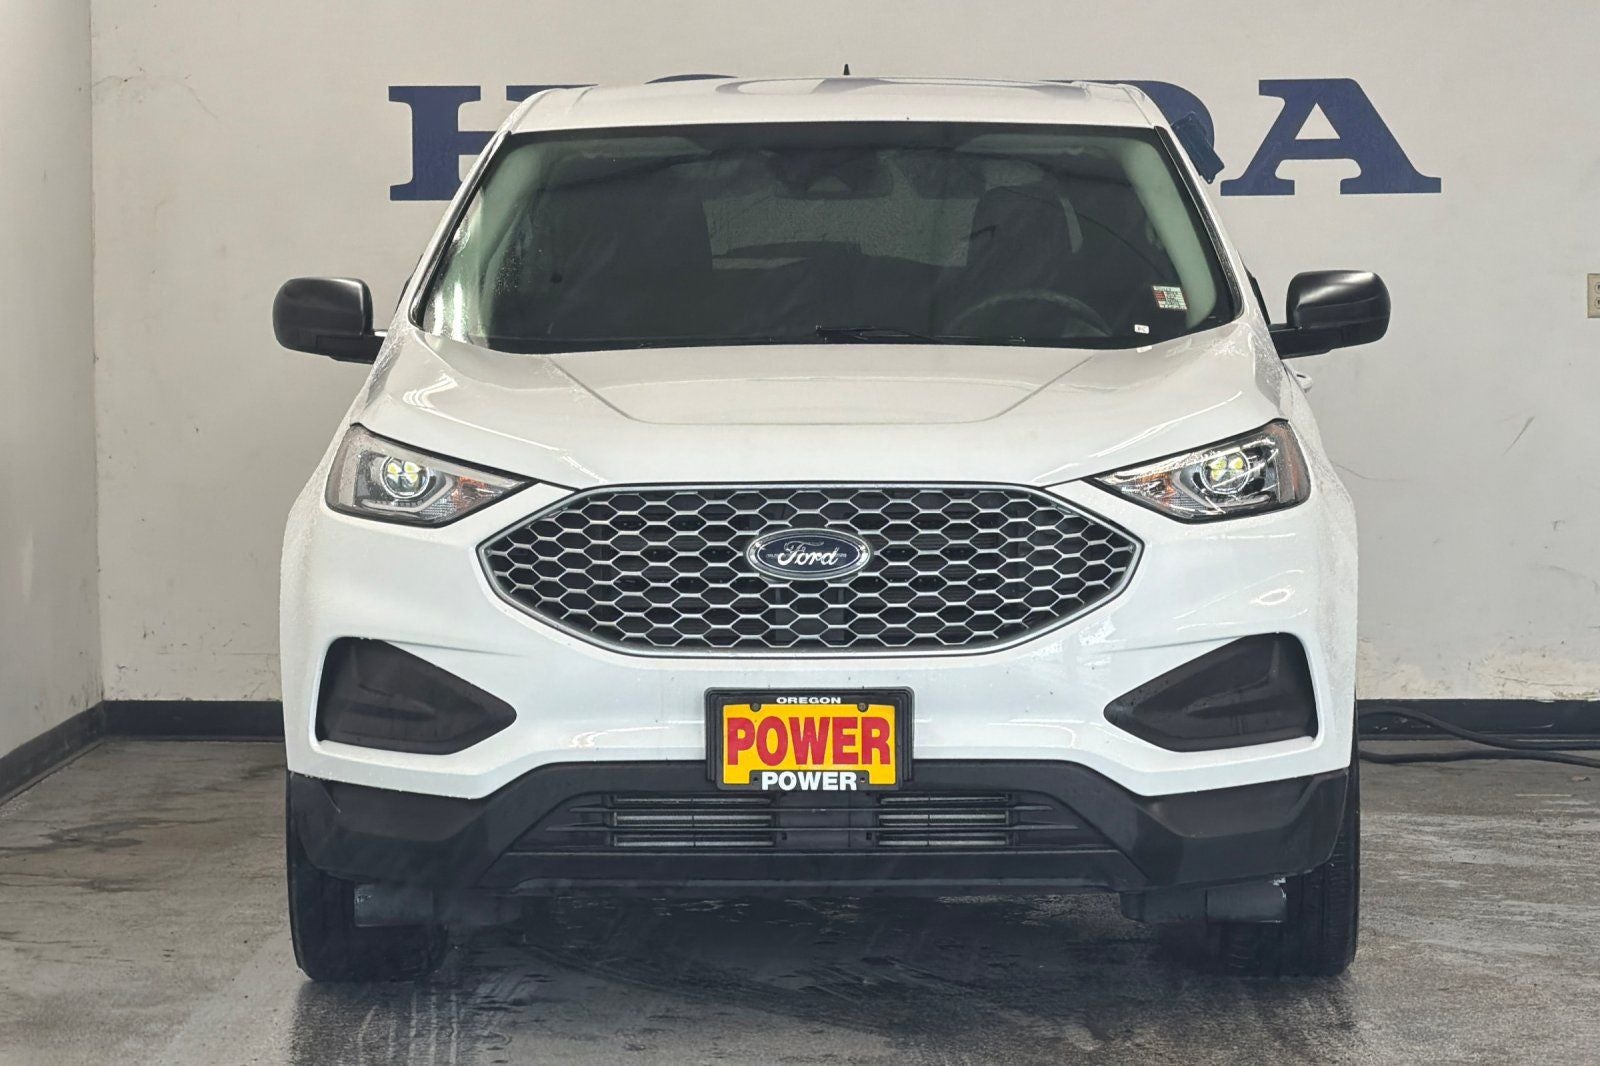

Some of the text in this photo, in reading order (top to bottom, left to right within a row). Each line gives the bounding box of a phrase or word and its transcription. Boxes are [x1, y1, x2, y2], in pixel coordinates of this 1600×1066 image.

[777, 540, 840, 565] Ford
[776, 696, 842, 705] OREGON
[727, 715, 891, 767] POWER
[761, 771, 858, 791] POWER
